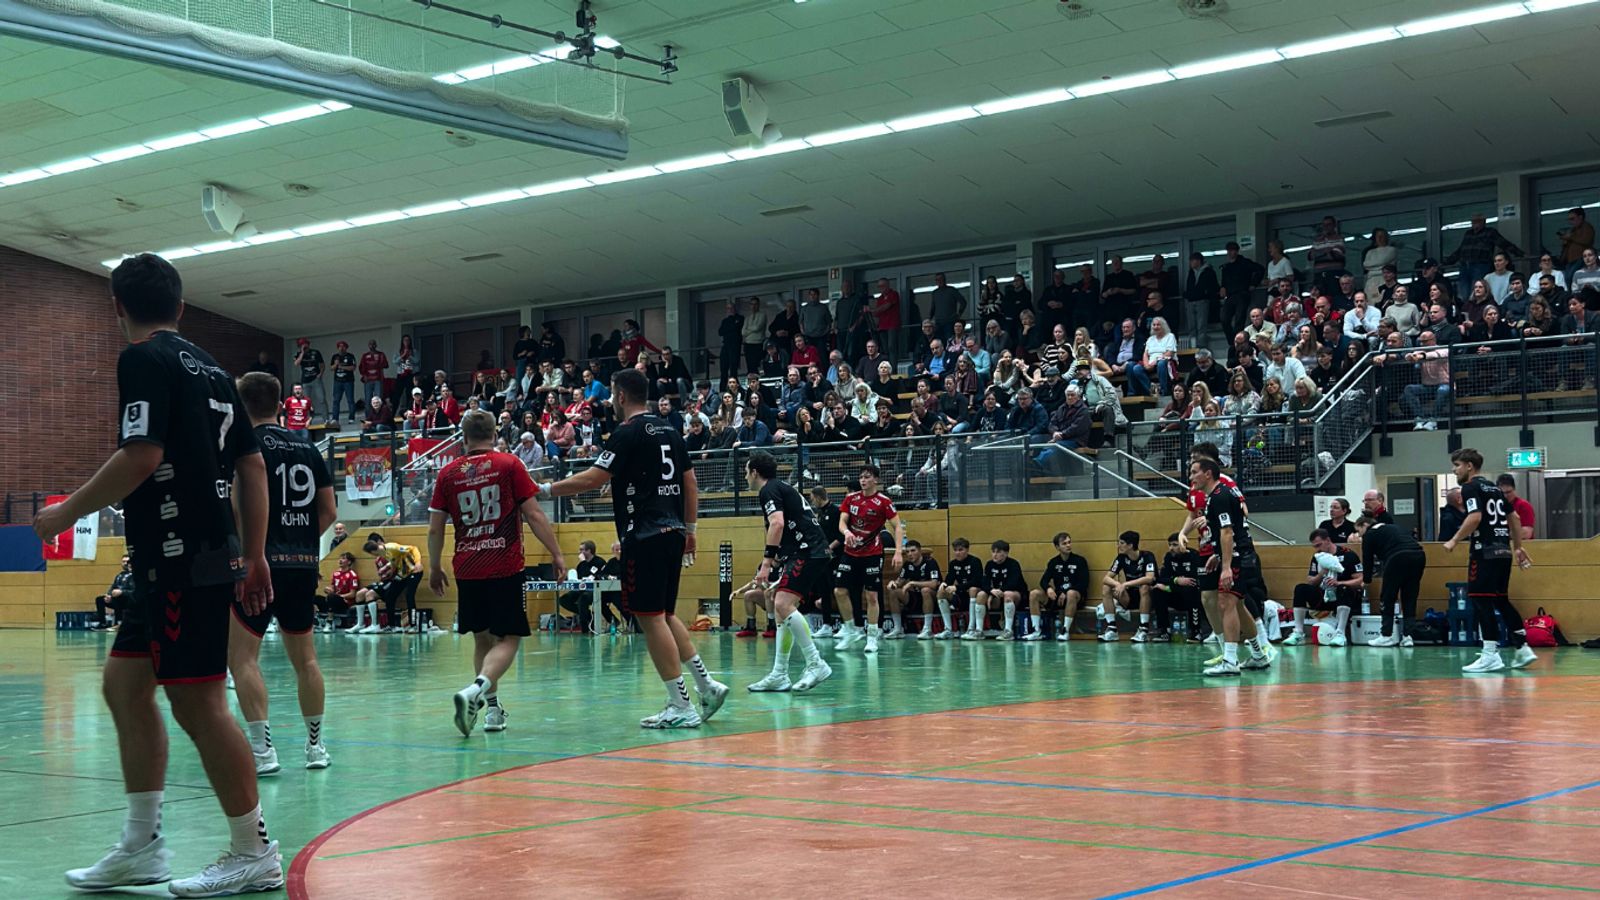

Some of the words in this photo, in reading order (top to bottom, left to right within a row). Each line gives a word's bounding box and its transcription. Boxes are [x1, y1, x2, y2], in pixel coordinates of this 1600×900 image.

[209, 398, 234, 451] 7
[660, 444, 675, 481] 5
[275, 462, 316, 507] 19
[457, 484, 502, 526] 98
[281, 510, 310, 527] KÜHN
